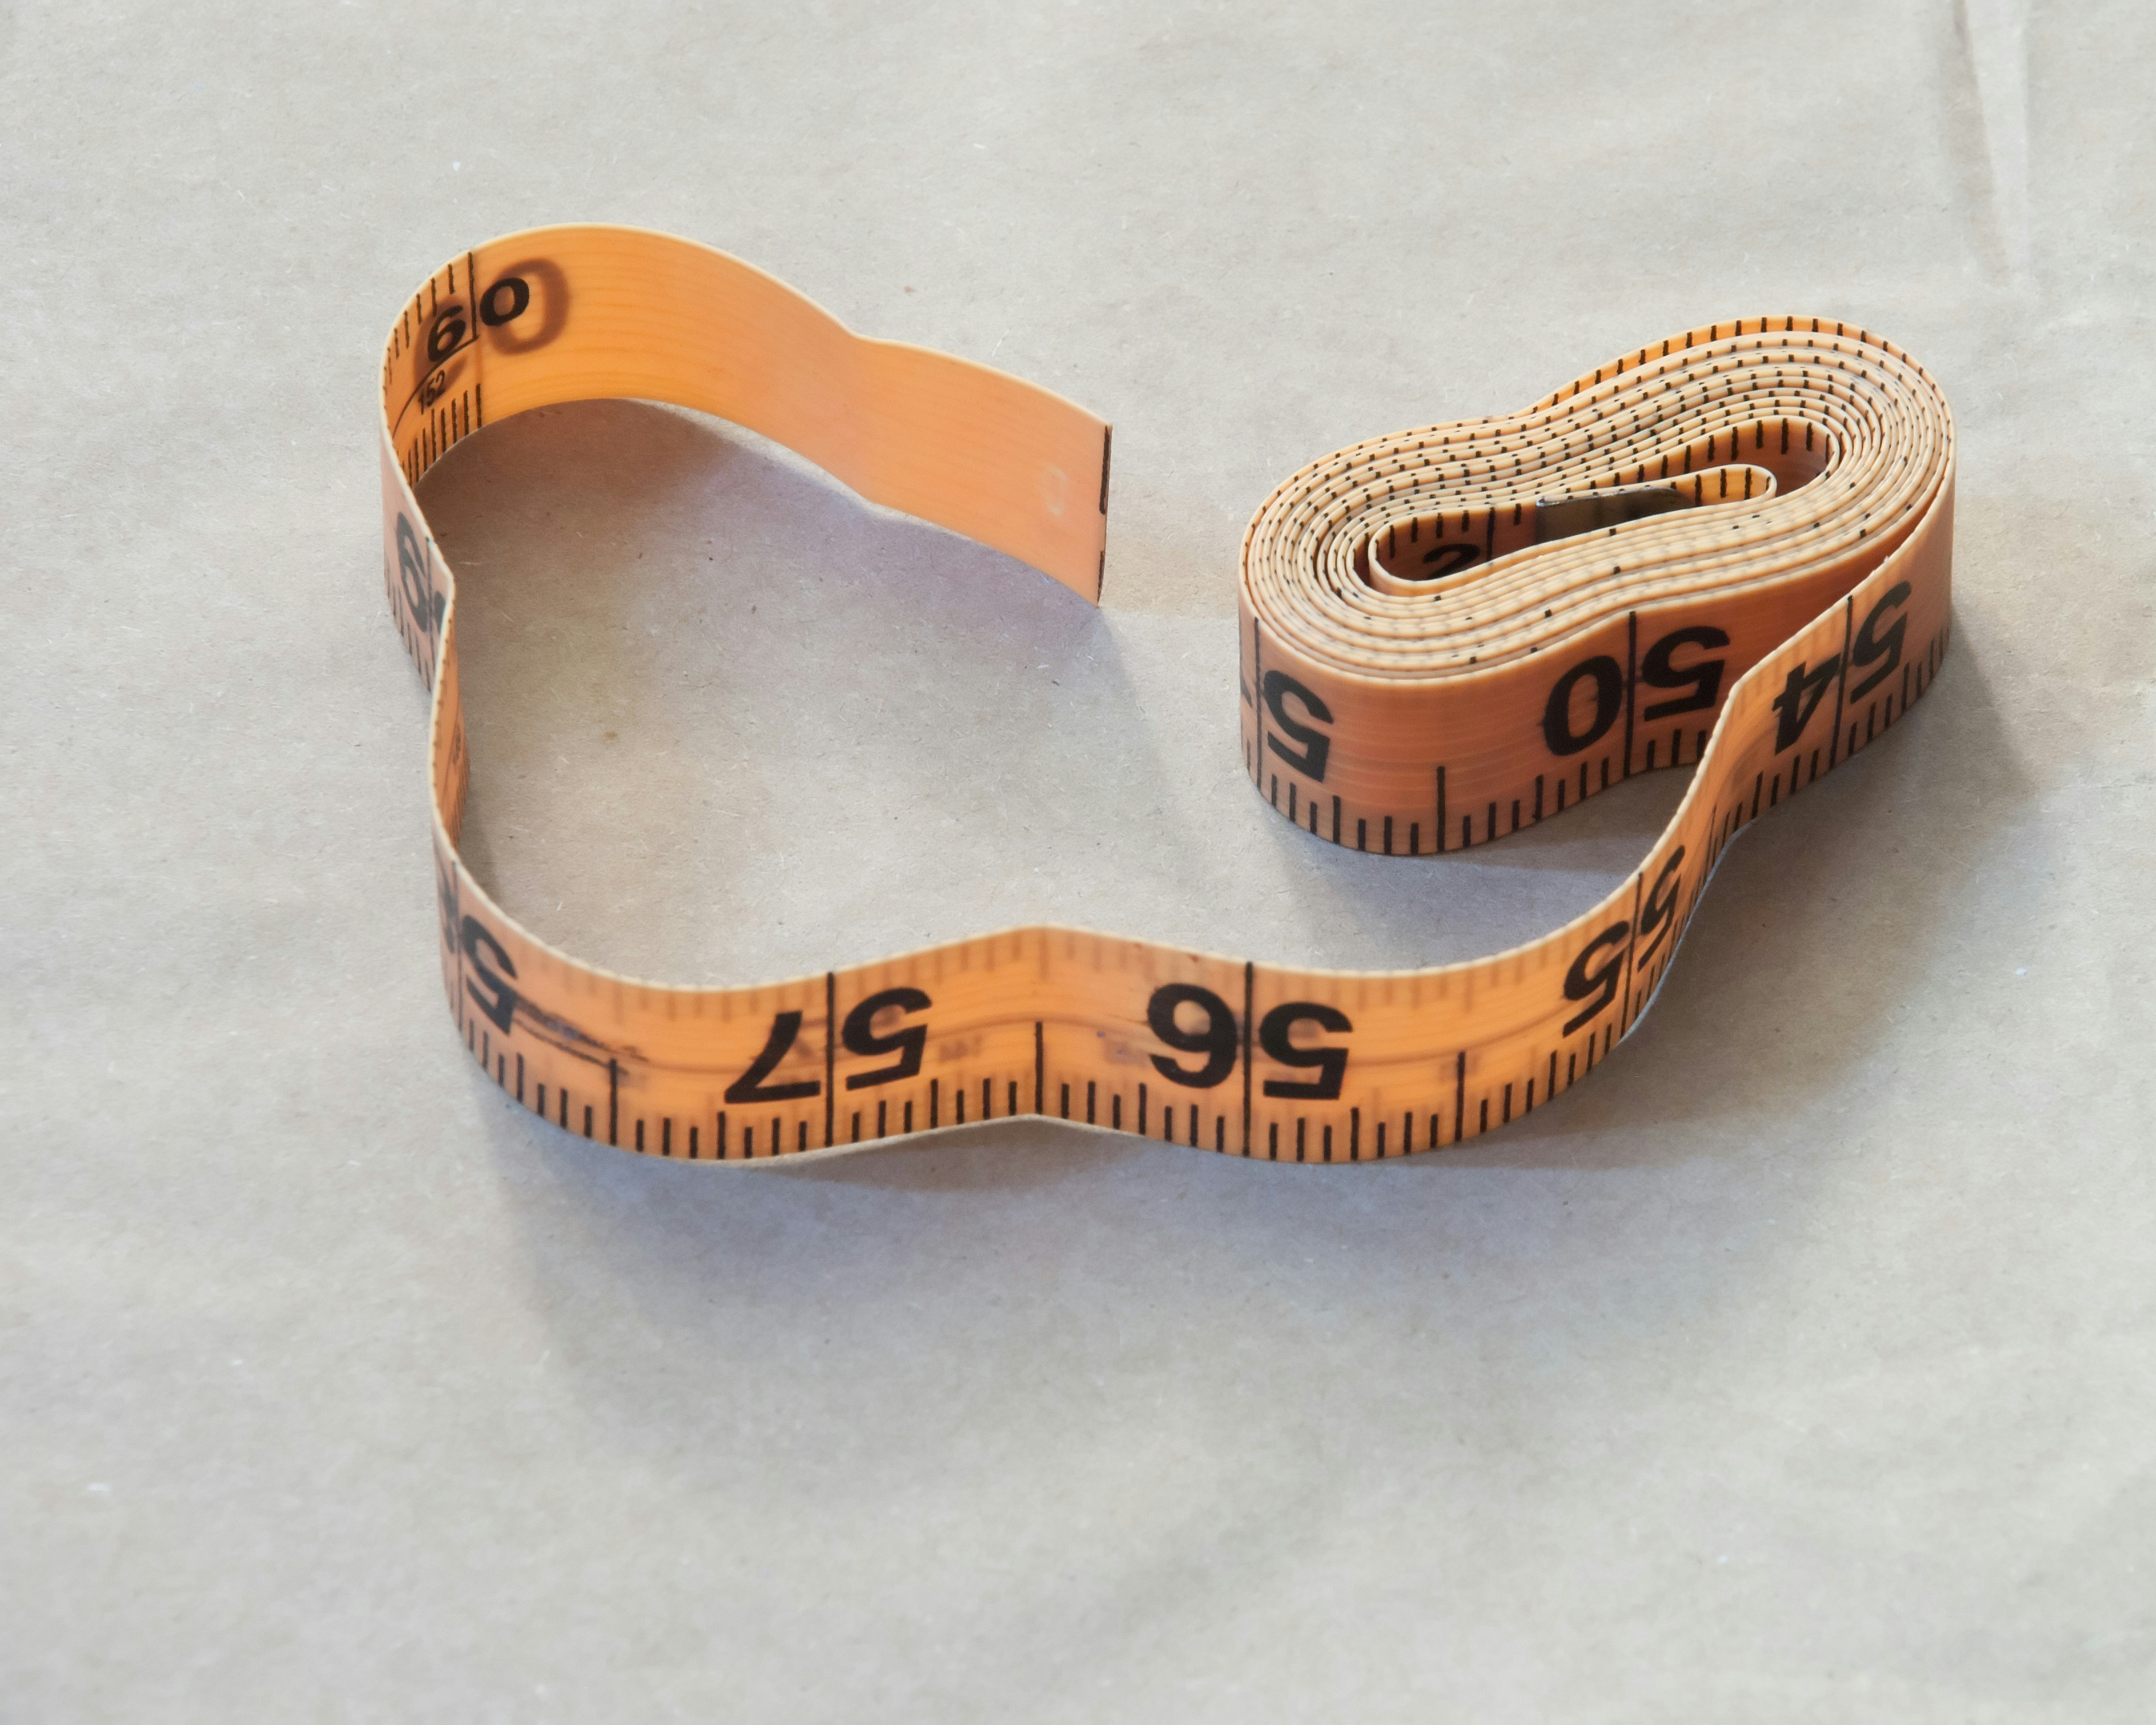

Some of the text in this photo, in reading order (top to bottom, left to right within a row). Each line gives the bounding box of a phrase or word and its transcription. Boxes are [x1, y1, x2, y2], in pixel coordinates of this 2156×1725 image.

[427, 277, 530, 362] 60
[1542, 626, 1730, 757] 50
[1771, 580, 1912, 756] 54
[1562, 845, 1686, 1038] 55
[724, 986, 932, 1105] 57
[1147, 982, 1353, 1100] 56
